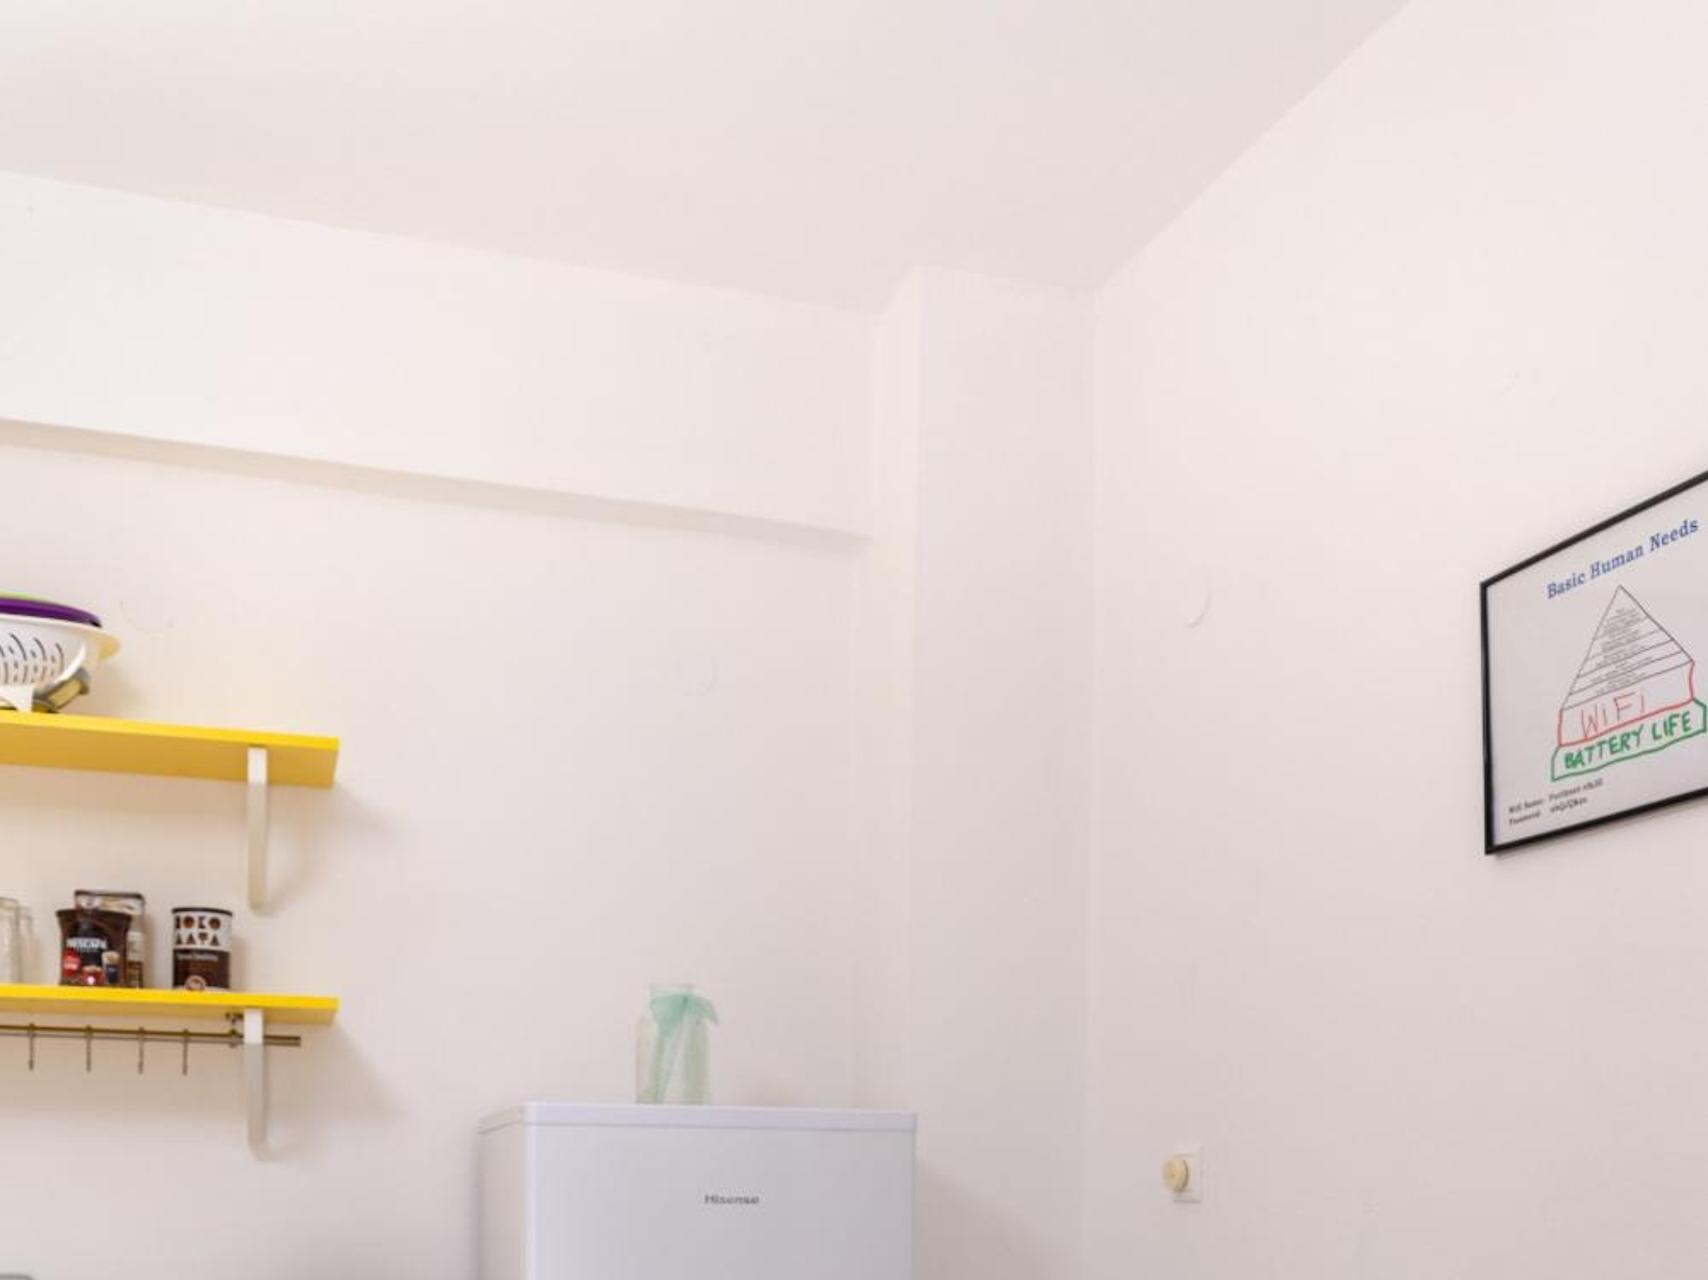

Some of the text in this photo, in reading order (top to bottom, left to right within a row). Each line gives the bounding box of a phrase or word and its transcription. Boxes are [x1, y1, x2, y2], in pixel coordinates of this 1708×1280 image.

[1547, 519, 1699, 599] Basic Human Needs
[1564, 711, 1692, 769] BATTERY LIFE
[705, 1194, 759, 1204] Hisense
